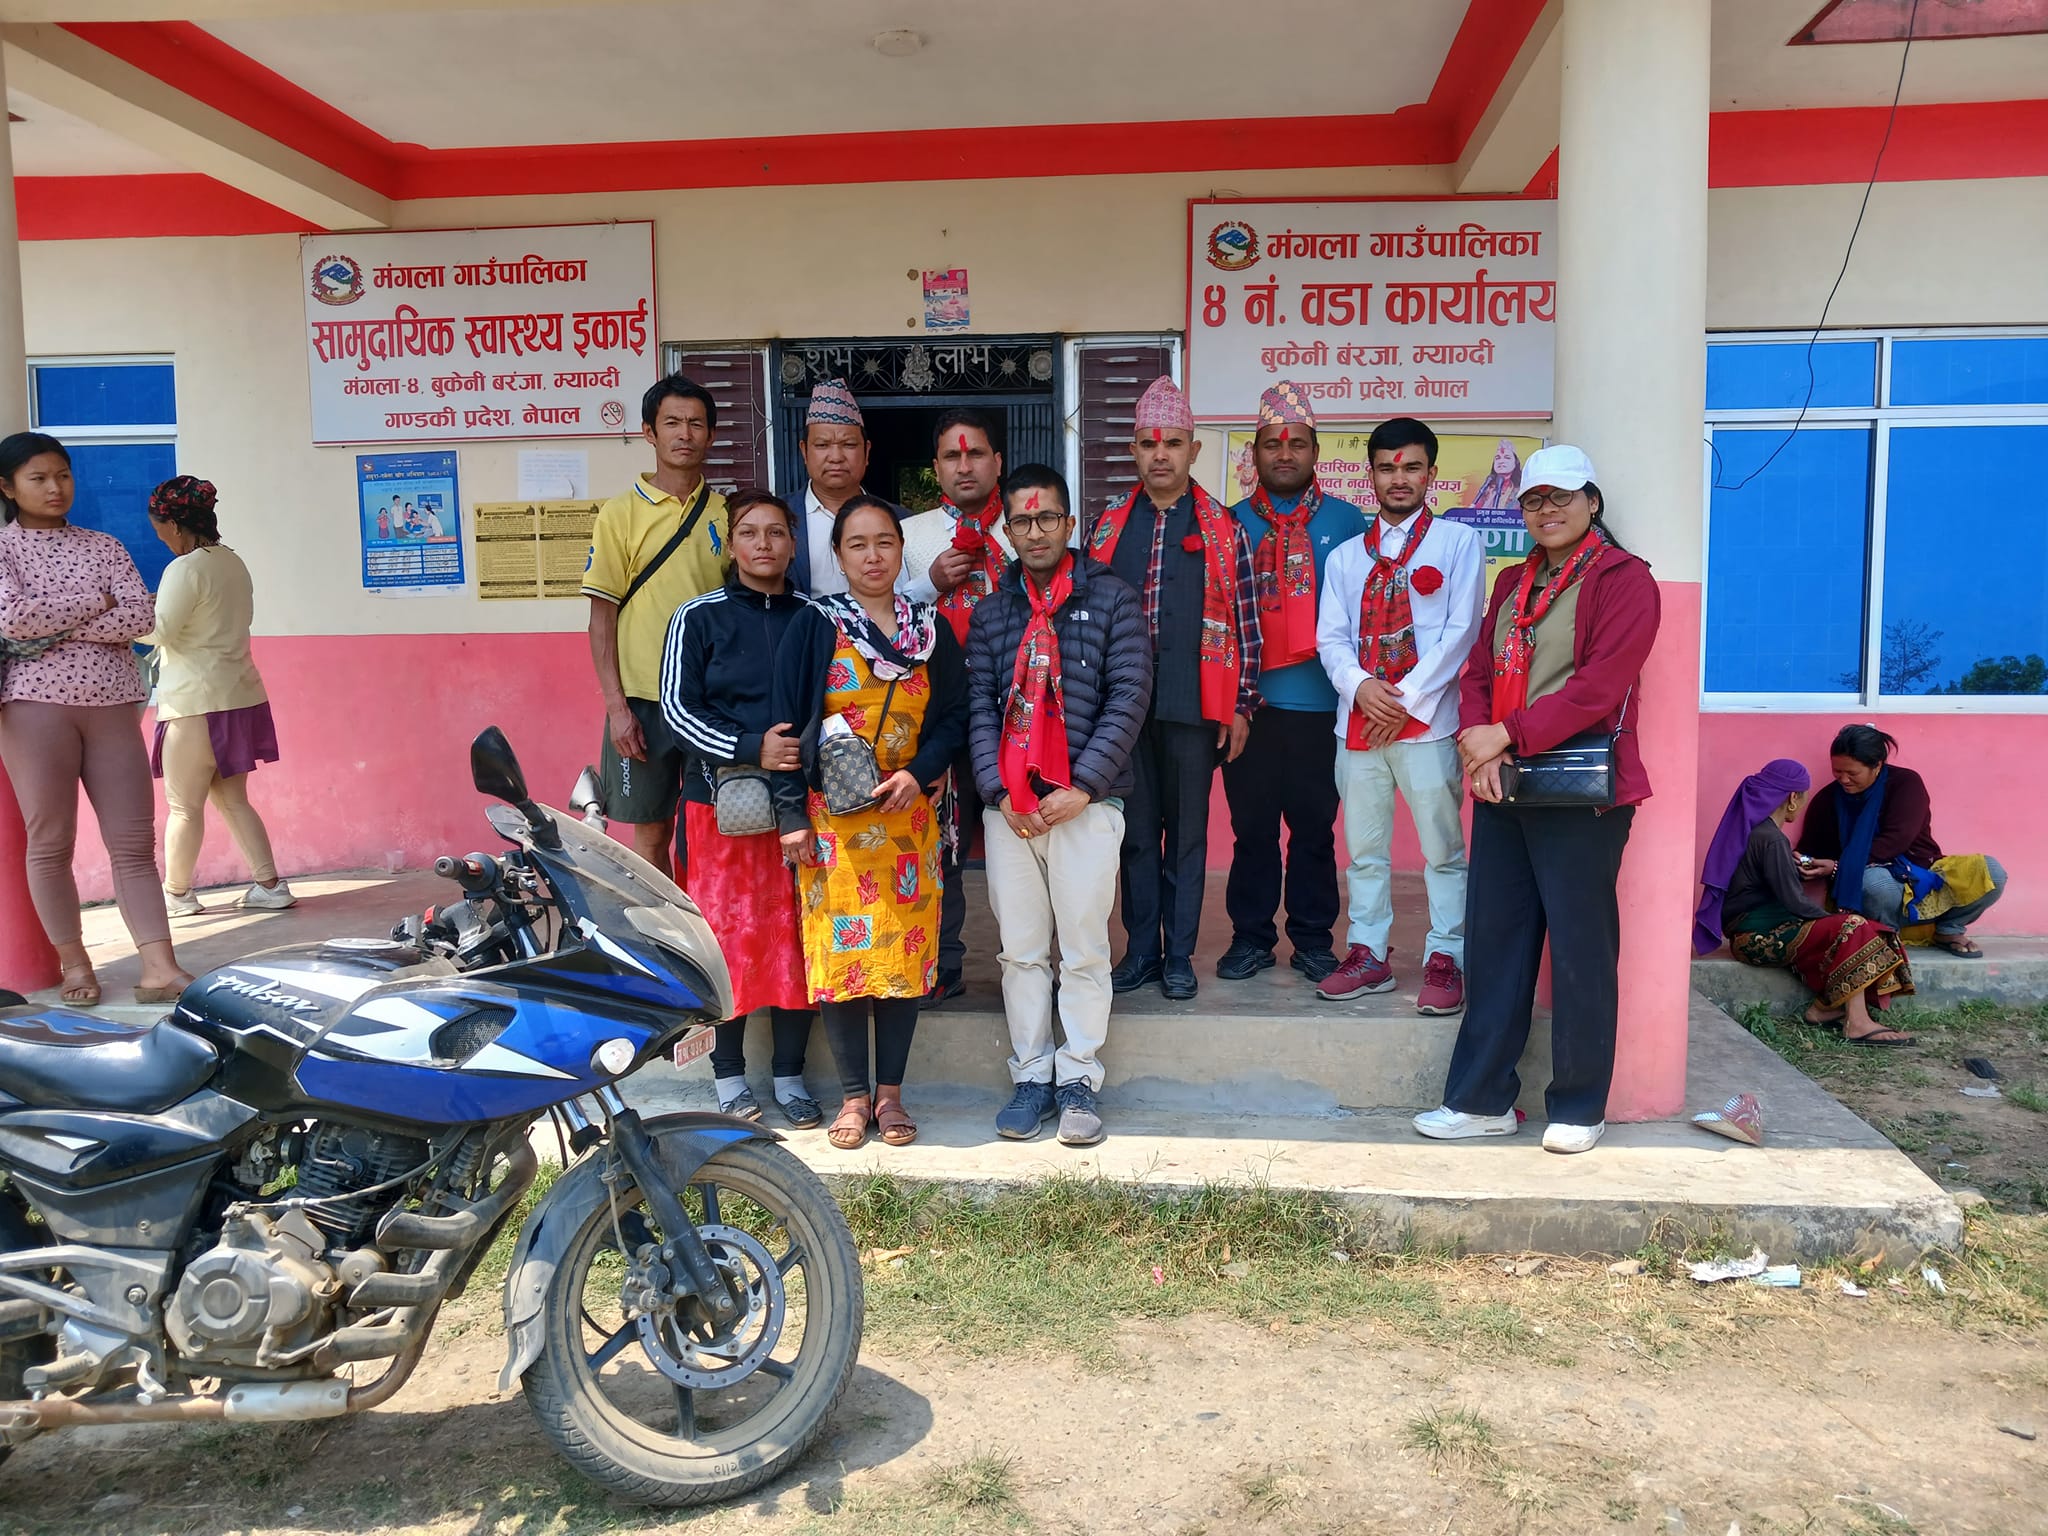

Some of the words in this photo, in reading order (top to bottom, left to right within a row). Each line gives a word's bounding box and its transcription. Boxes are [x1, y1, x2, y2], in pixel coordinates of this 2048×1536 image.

[1267, 229, 1360, 260] मंगला
[1370, 223, 1542, 258] गाउँपालिका
[373, 263, 446, 288] मंगला
[454, 254, 588, 286] गाउँपालिका
[1203, 285, 1227, 328] ४
[1244, 274, 1287, 327] नं.
[1302, 283, 1373, 326] वडा
[1386, 268, 1557, 327] कार्यालय
[311, 304, 456, 371] सामुदायिक
[464, 313, 564, 359] स्वास्थ्य
[572, 297, 649, 359] इकाई
[806, 347, 854, 382] शुभ
[933, 345, 992, 375] लाभ
[1261, 340, 1330, 373] बुकेनी
[1413, 338, 1495, 366] म्याग्दी
[431, 371, 487, 398] बुकेनी
[553, 366, 621, 388] म्याग्दी
[1414, 375, 1470, 399] नेपाल
[385, 407, 457, 428] गण्डकी
[522, 403, 581, 425] नेपाल
